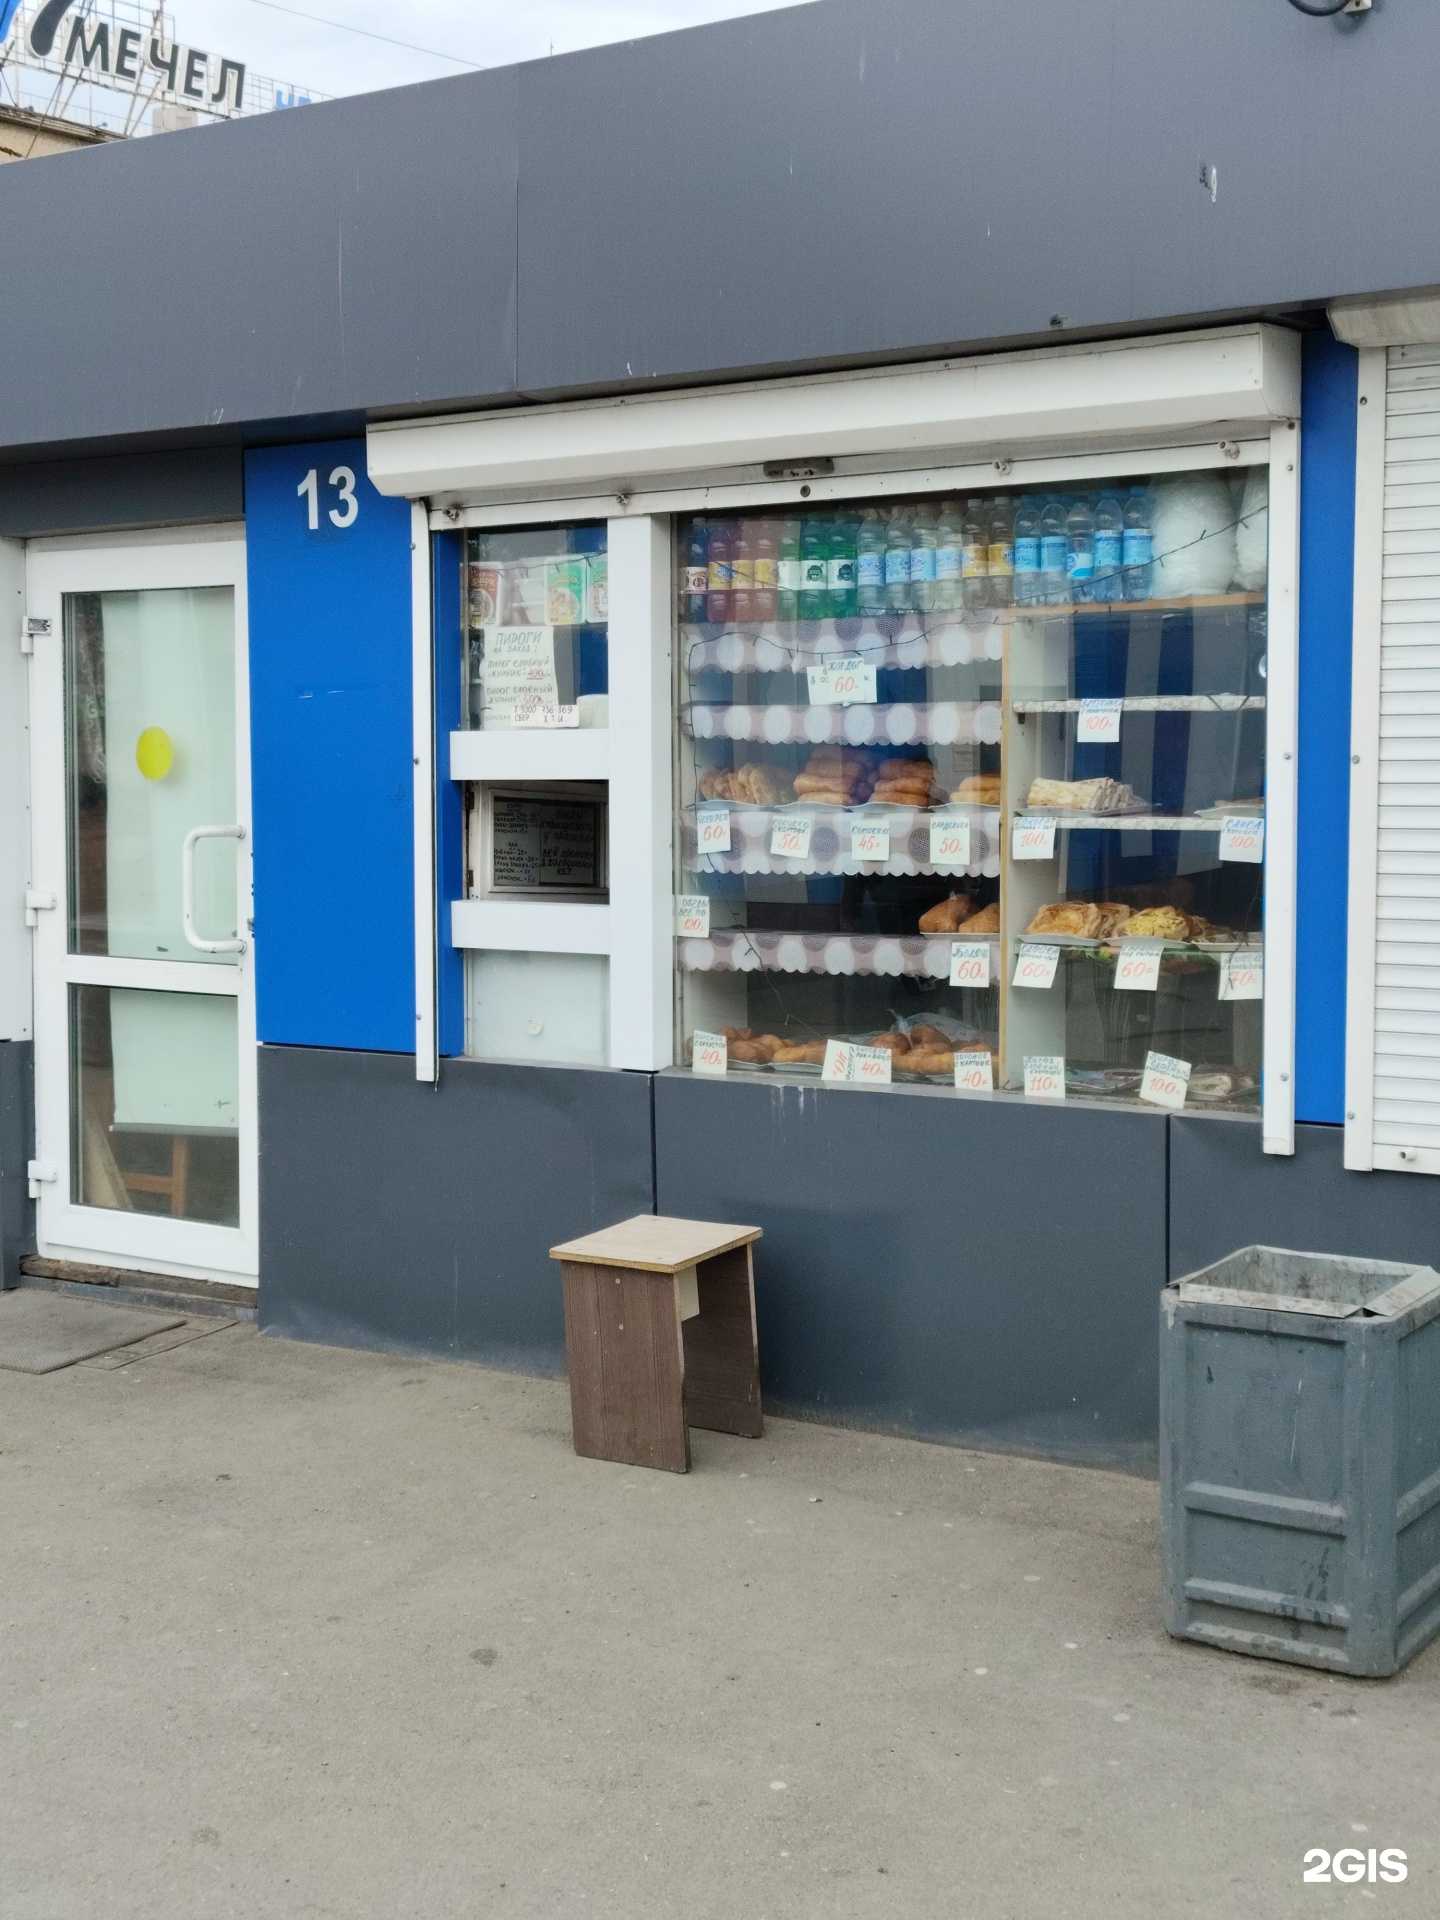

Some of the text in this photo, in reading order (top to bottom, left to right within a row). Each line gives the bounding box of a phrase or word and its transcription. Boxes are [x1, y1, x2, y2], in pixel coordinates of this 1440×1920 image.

[64, 16, 246, 109] МЕЧЕЛ
[297, 466, 359, 530] 13
[496, 631, 543, 646] ПИРОГИ
